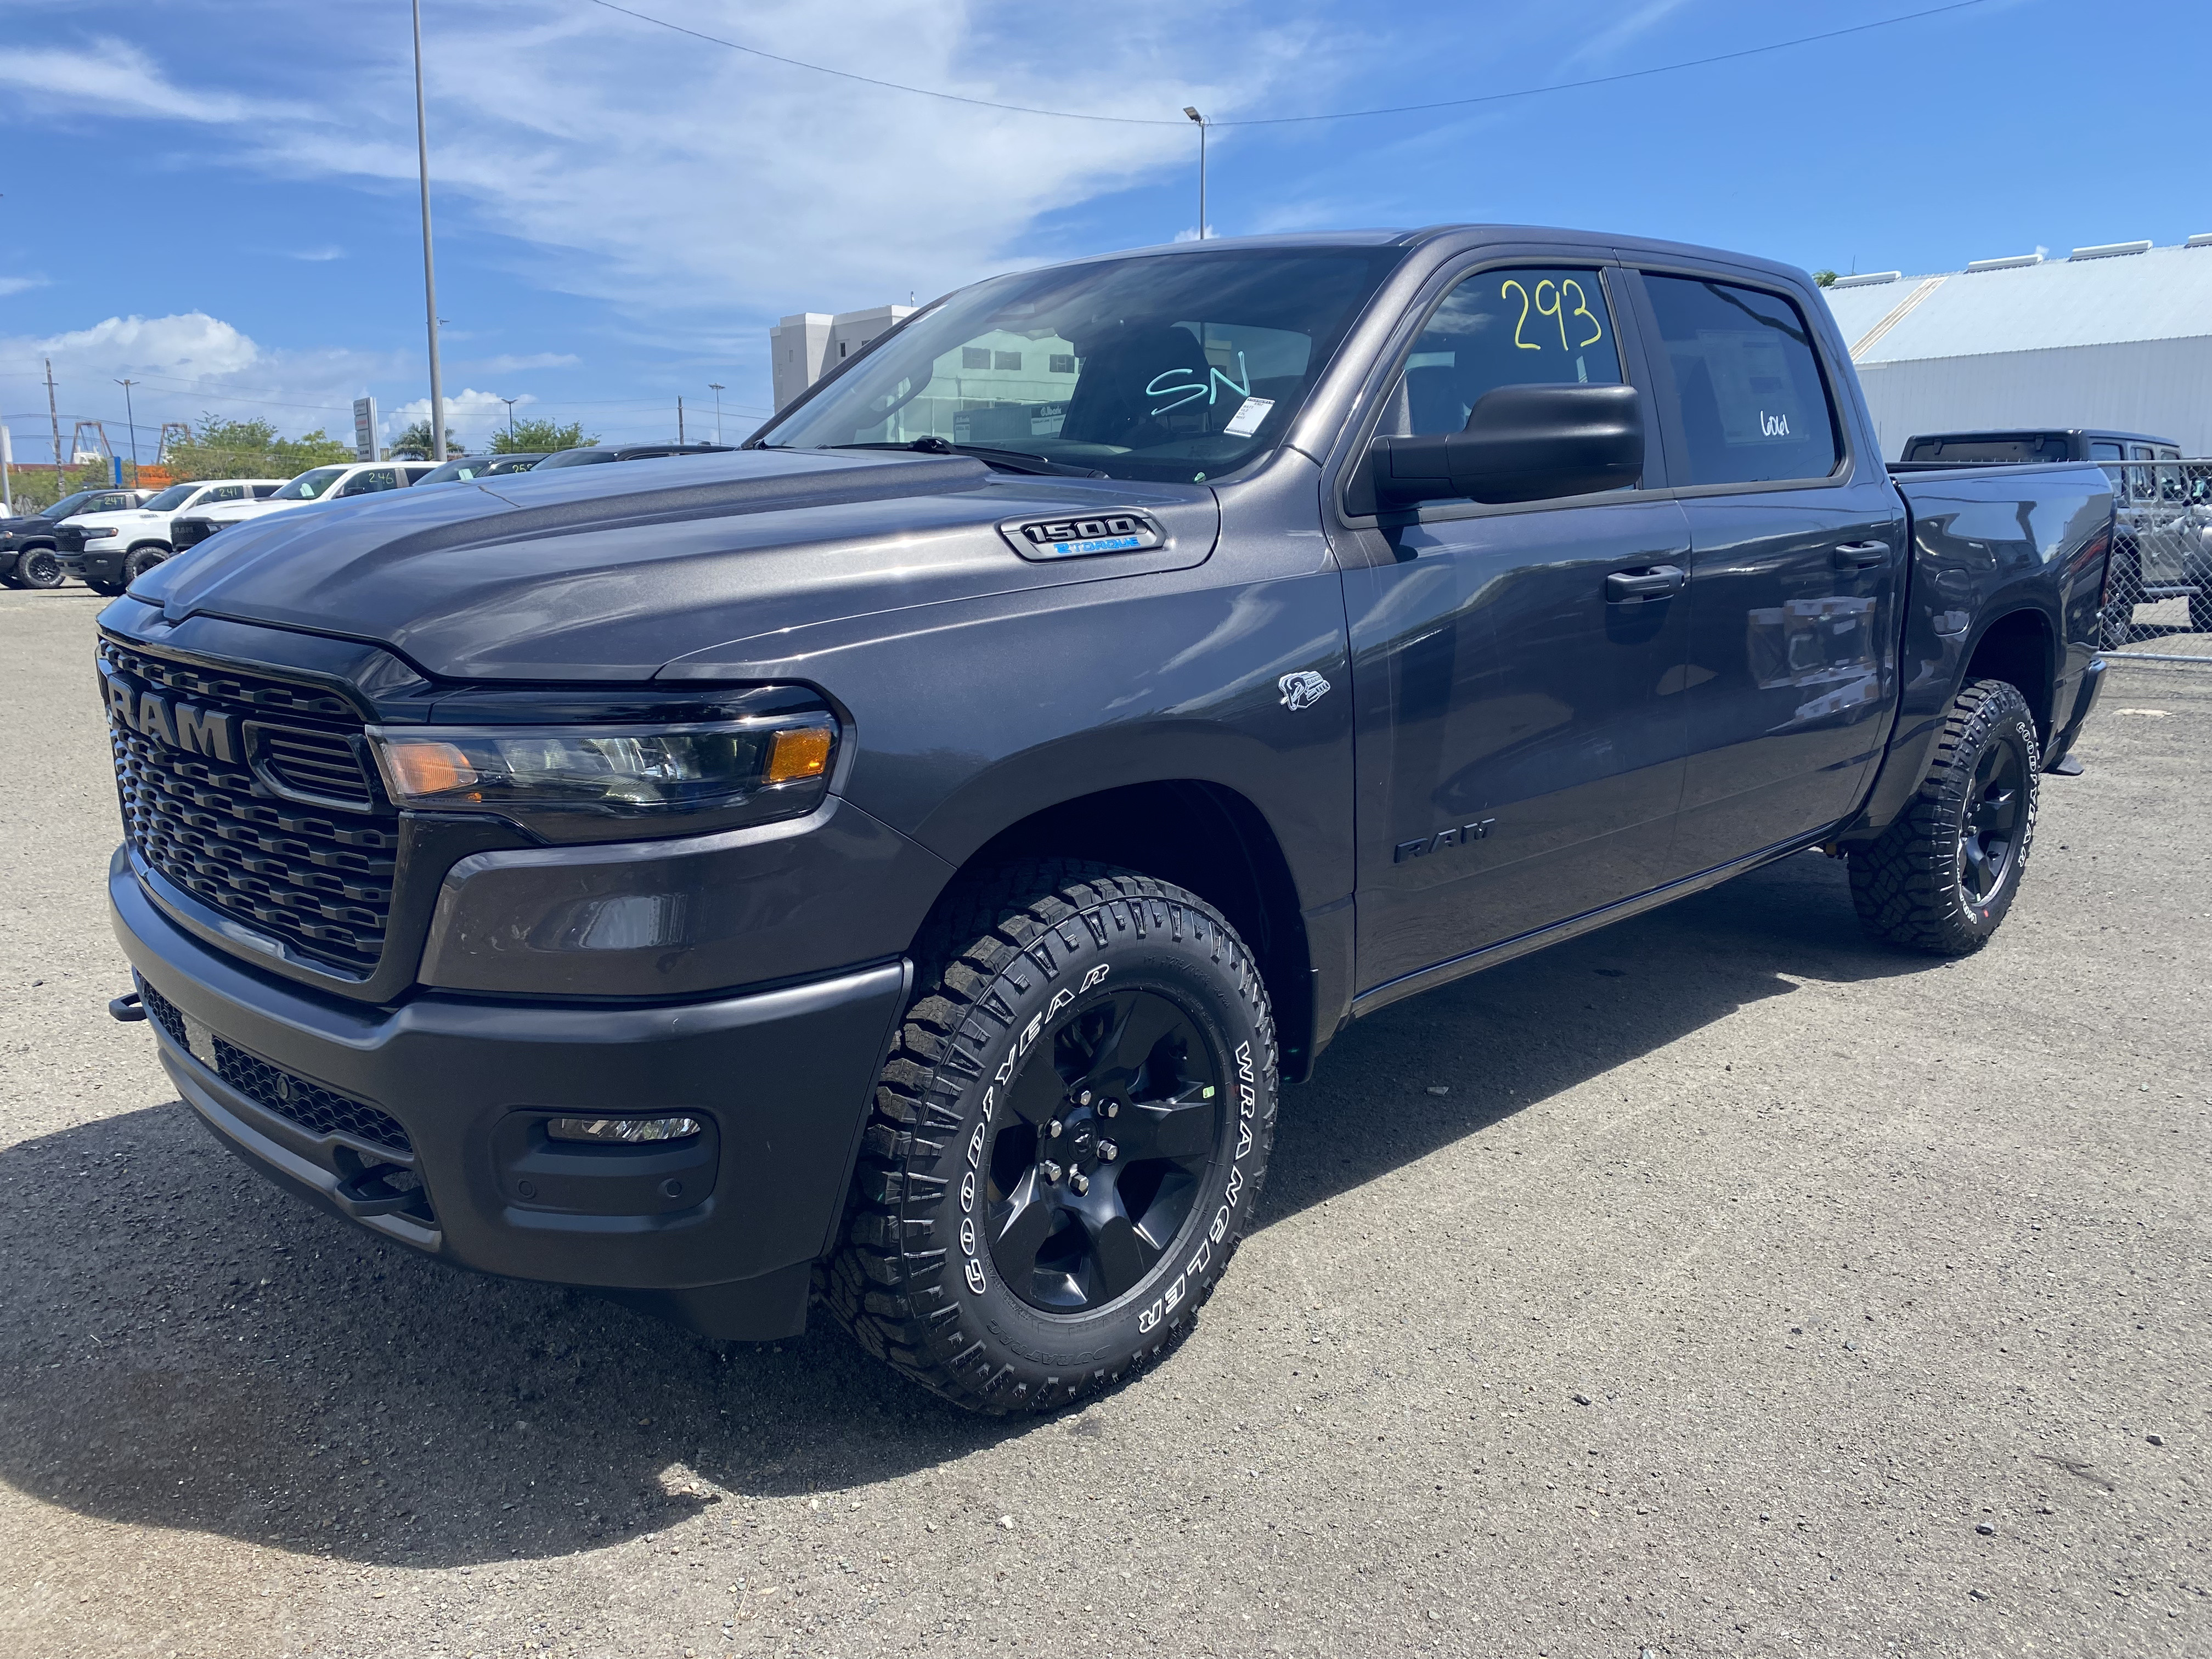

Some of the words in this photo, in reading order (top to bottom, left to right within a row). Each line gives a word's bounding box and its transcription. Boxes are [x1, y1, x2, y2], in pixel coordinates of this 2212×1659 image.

[1502, 279, 1602, 351] 293
[1146, 351, 1251, 415] SN
[104, 496, 123, 505] 247
[219, 488, 236, 497] 241
[369, 472, 394, 484] 246
[1025, 517, 1137, 543] 1500
[108, 672, 238, 764] RAM
[2016, 721, 2038, 867] GOODYEAR
[1393, 817, 1496, 864] RAM
[961, 963, 1110, 1294] GOODYEAR
[1139, 1040, 1255, 1334] WRANGLER
